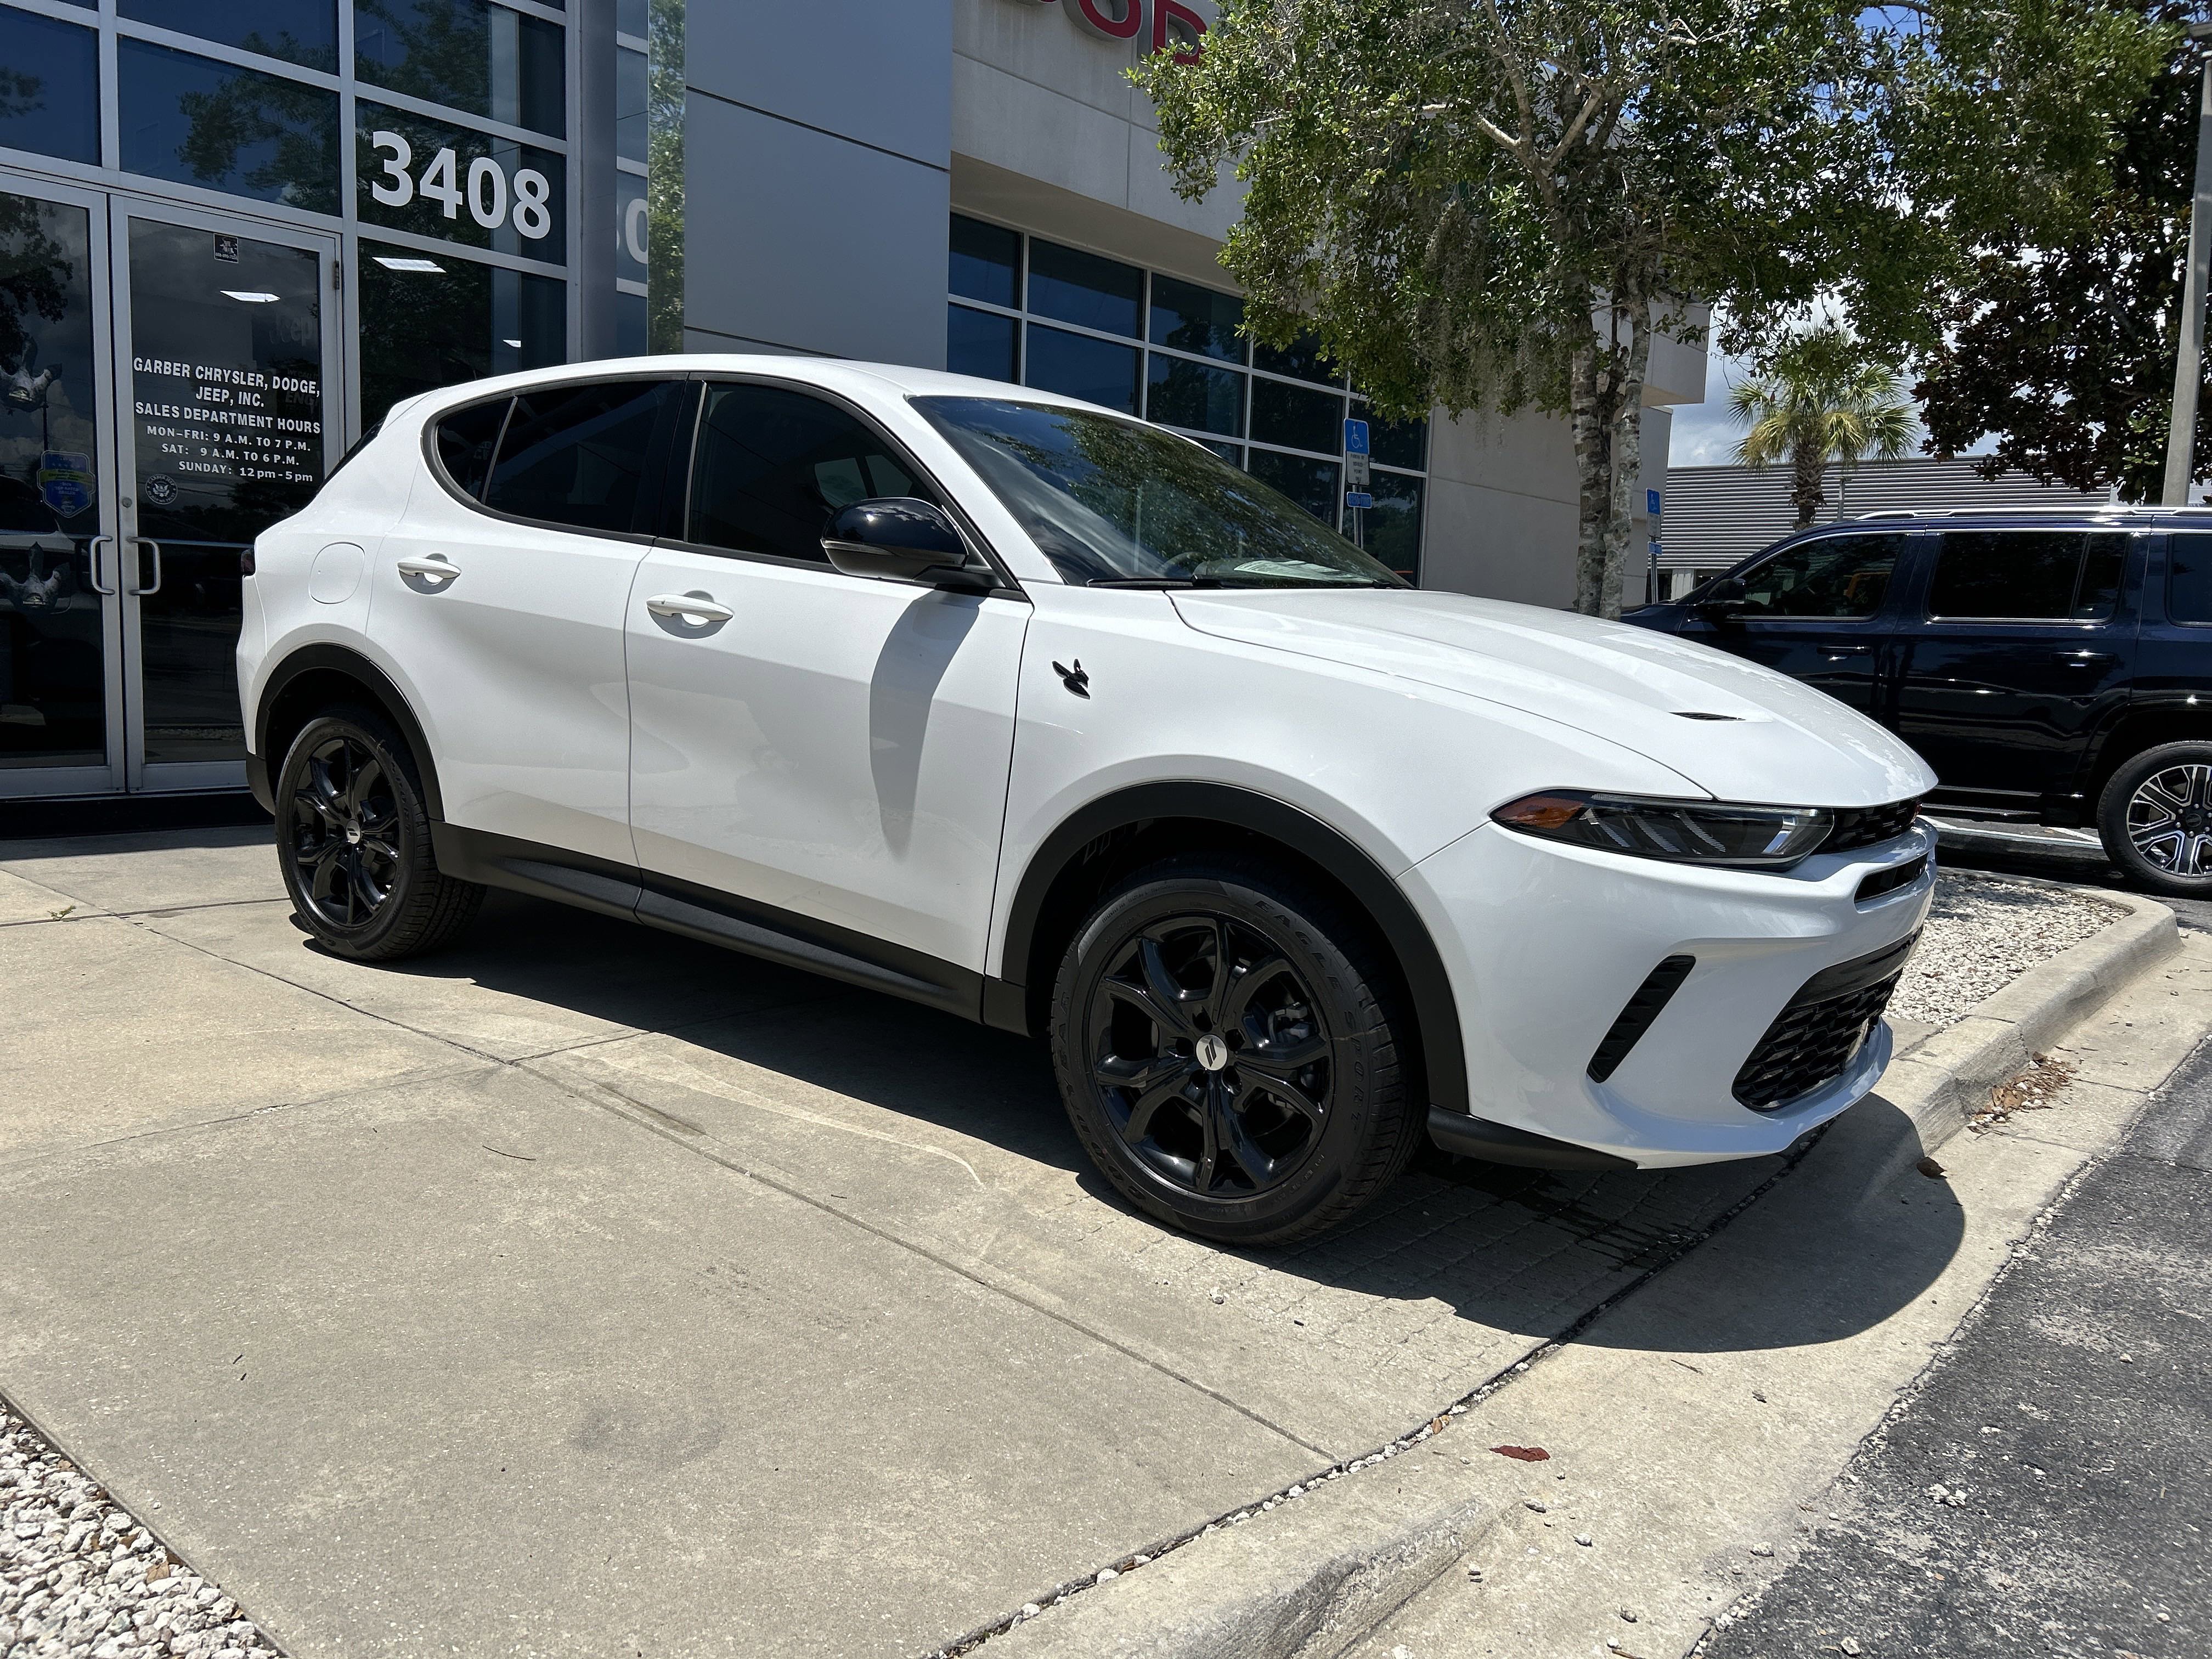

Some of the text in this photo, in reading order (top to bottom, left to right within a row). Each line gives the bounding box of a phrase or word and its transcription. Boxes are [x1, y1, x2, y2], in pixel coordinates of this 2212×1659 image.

[372, 131, 551, 240] 3408
[133, 357, 320, 398] GARBER CHRYSLER, DODGE,
[195, 386, 264, 407] JEEP, INC.
[136, 402, 320, 434] SALES DEPARTMENT HOURS
[161, 443, 299, 465] SAT: 9 A.M. TO 6 P.M.
[213, 433, 221, 442] 9
[225, 434, 252, 445] A.M.
[256, 437, 271, 447] TO
[275, 439, 281, 448] 7
[285, 440, 311, 452] P.M.
[179, 461, 232, 475] SUNDAY:
[1254, 899, 1345, 994] EAGLE
[1344, 1010, 1366, 1135] SPORT
